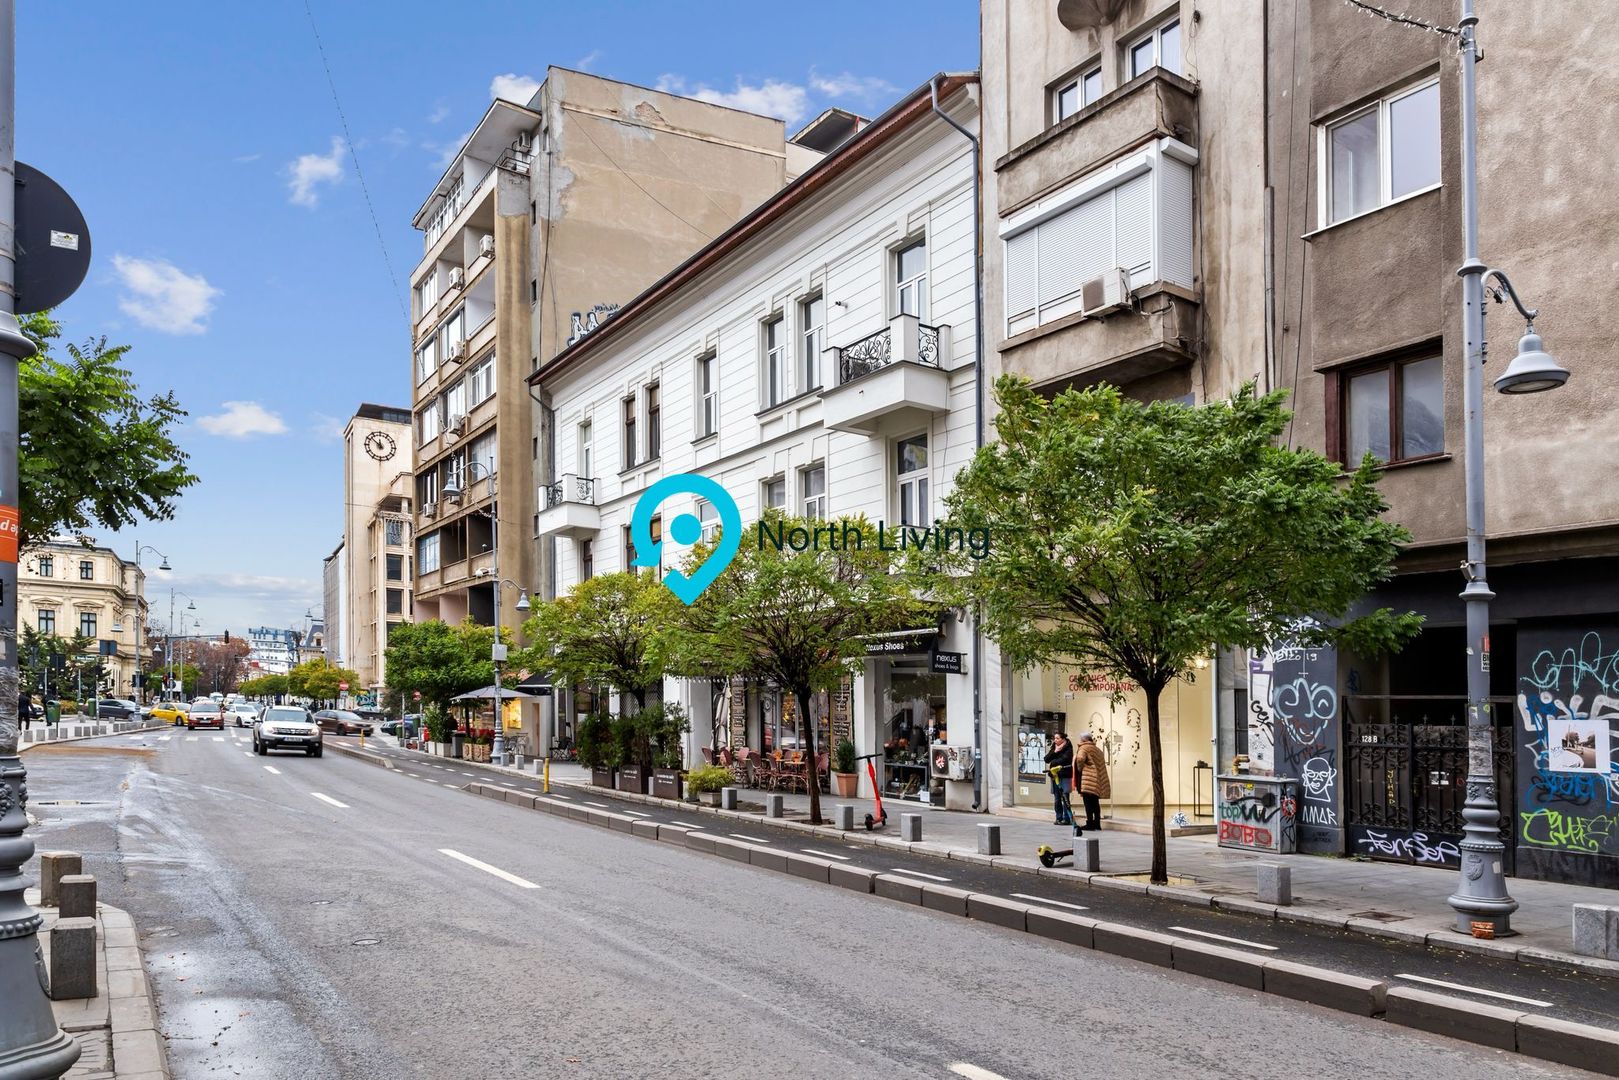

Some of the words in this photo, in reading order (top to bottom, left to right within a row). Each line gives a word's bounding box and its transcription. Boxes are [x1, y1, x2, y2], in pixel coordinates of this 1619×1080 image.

[884, 642, 904, 651] Shoes
[936, 654, 958, 663] nexus
[1361, 735, 1372, 743] 128
[1373, 735, 1378, 743] B
[1219, 820, 1273, 847] BOBO
